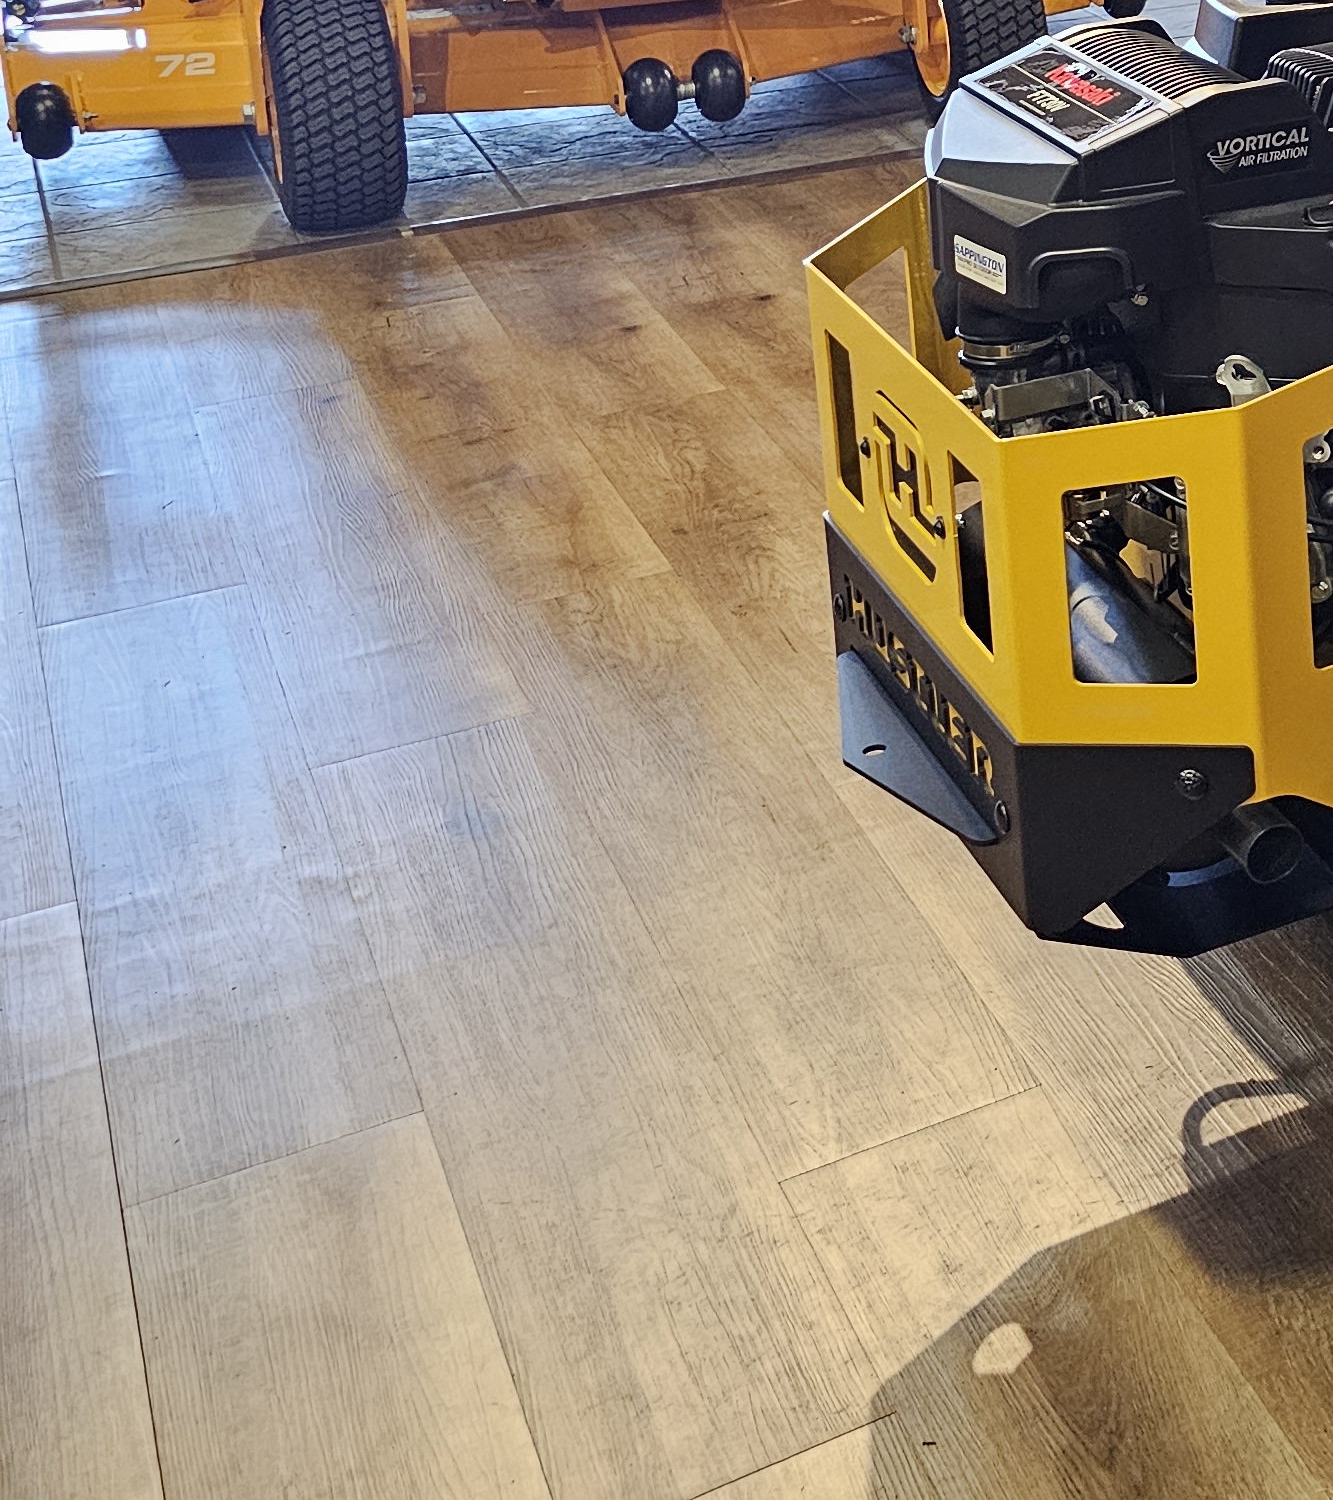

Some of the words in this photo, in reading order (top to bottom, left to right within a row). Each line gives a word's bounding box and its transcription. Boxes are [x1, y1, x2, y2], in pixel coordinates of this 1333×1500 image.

[155, 52, 216, 78] 72
[1045, 63, 1121, 106] Kawasaki
[1217, 127, 1309, 156] VORTICAL
[1238, 155, 1256, 168] AIR
[1256, 146, 1309, 165] FILTRATION
